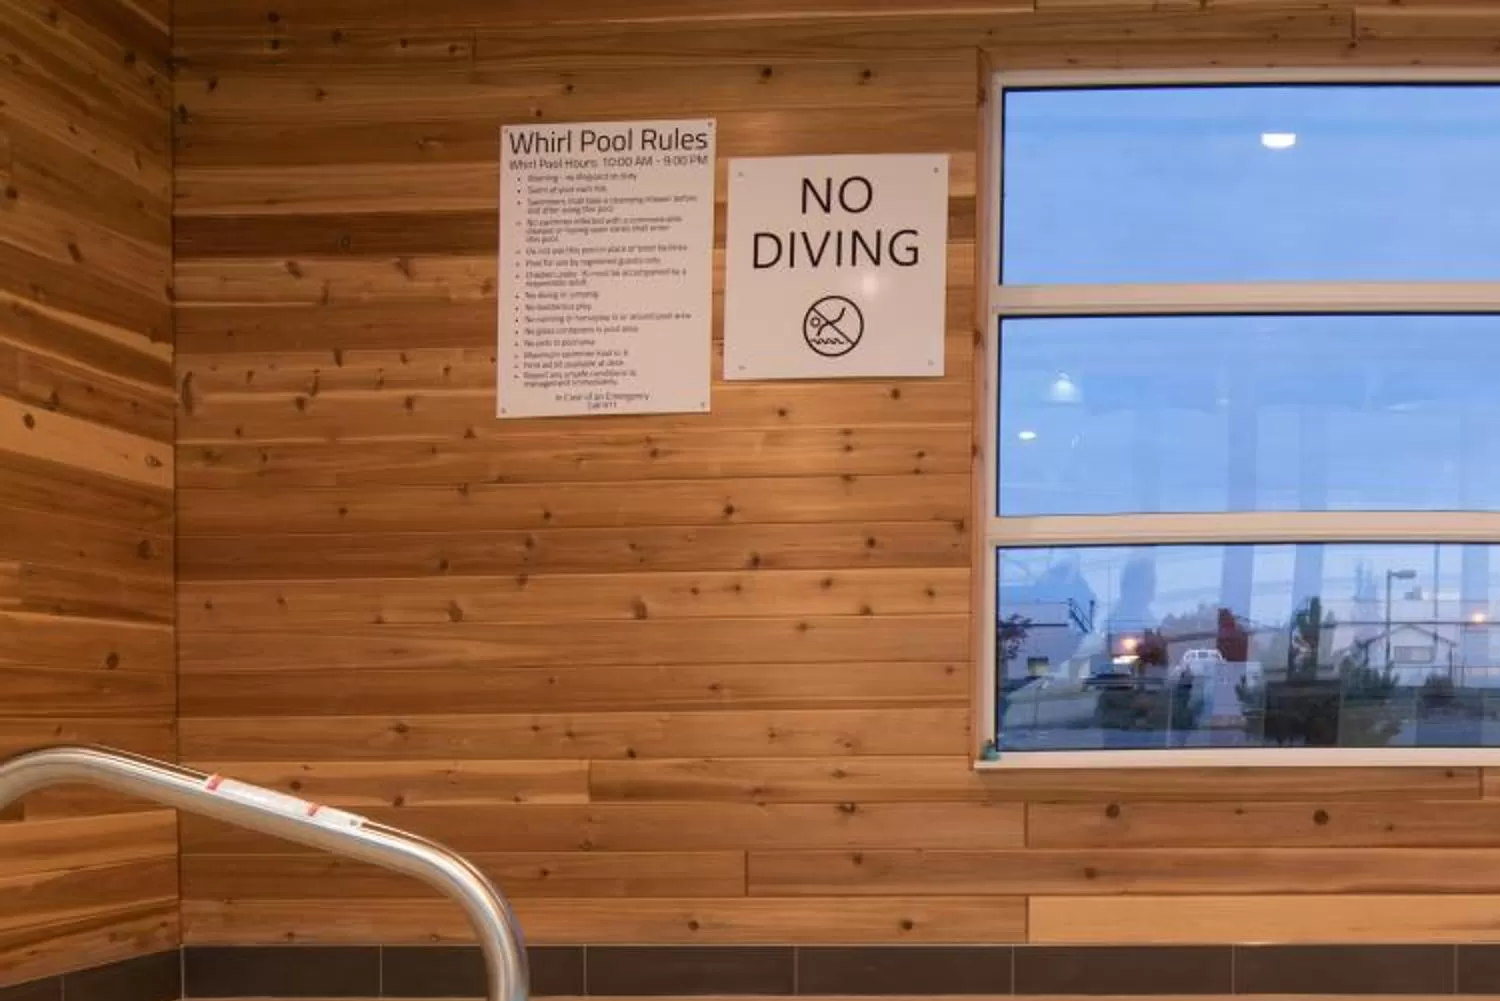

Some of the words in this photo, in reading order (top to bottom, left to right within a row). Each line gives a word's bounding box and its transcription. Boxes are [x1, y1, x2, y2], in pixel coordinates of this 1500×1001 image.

[509, 129, 573, 154] Whirl
[580, 128, 632, 152] Pool
[641, 127, 709, 151] Rules
[509, 158, 537, 170] Whirl
[539, 158, 563, 168] Pool
[635, 156, 653, 167] AM
[689, 155, 708, 166] PM
[801, 175, 873, 215] NO
[753, 229, 920, 269] DIVING
